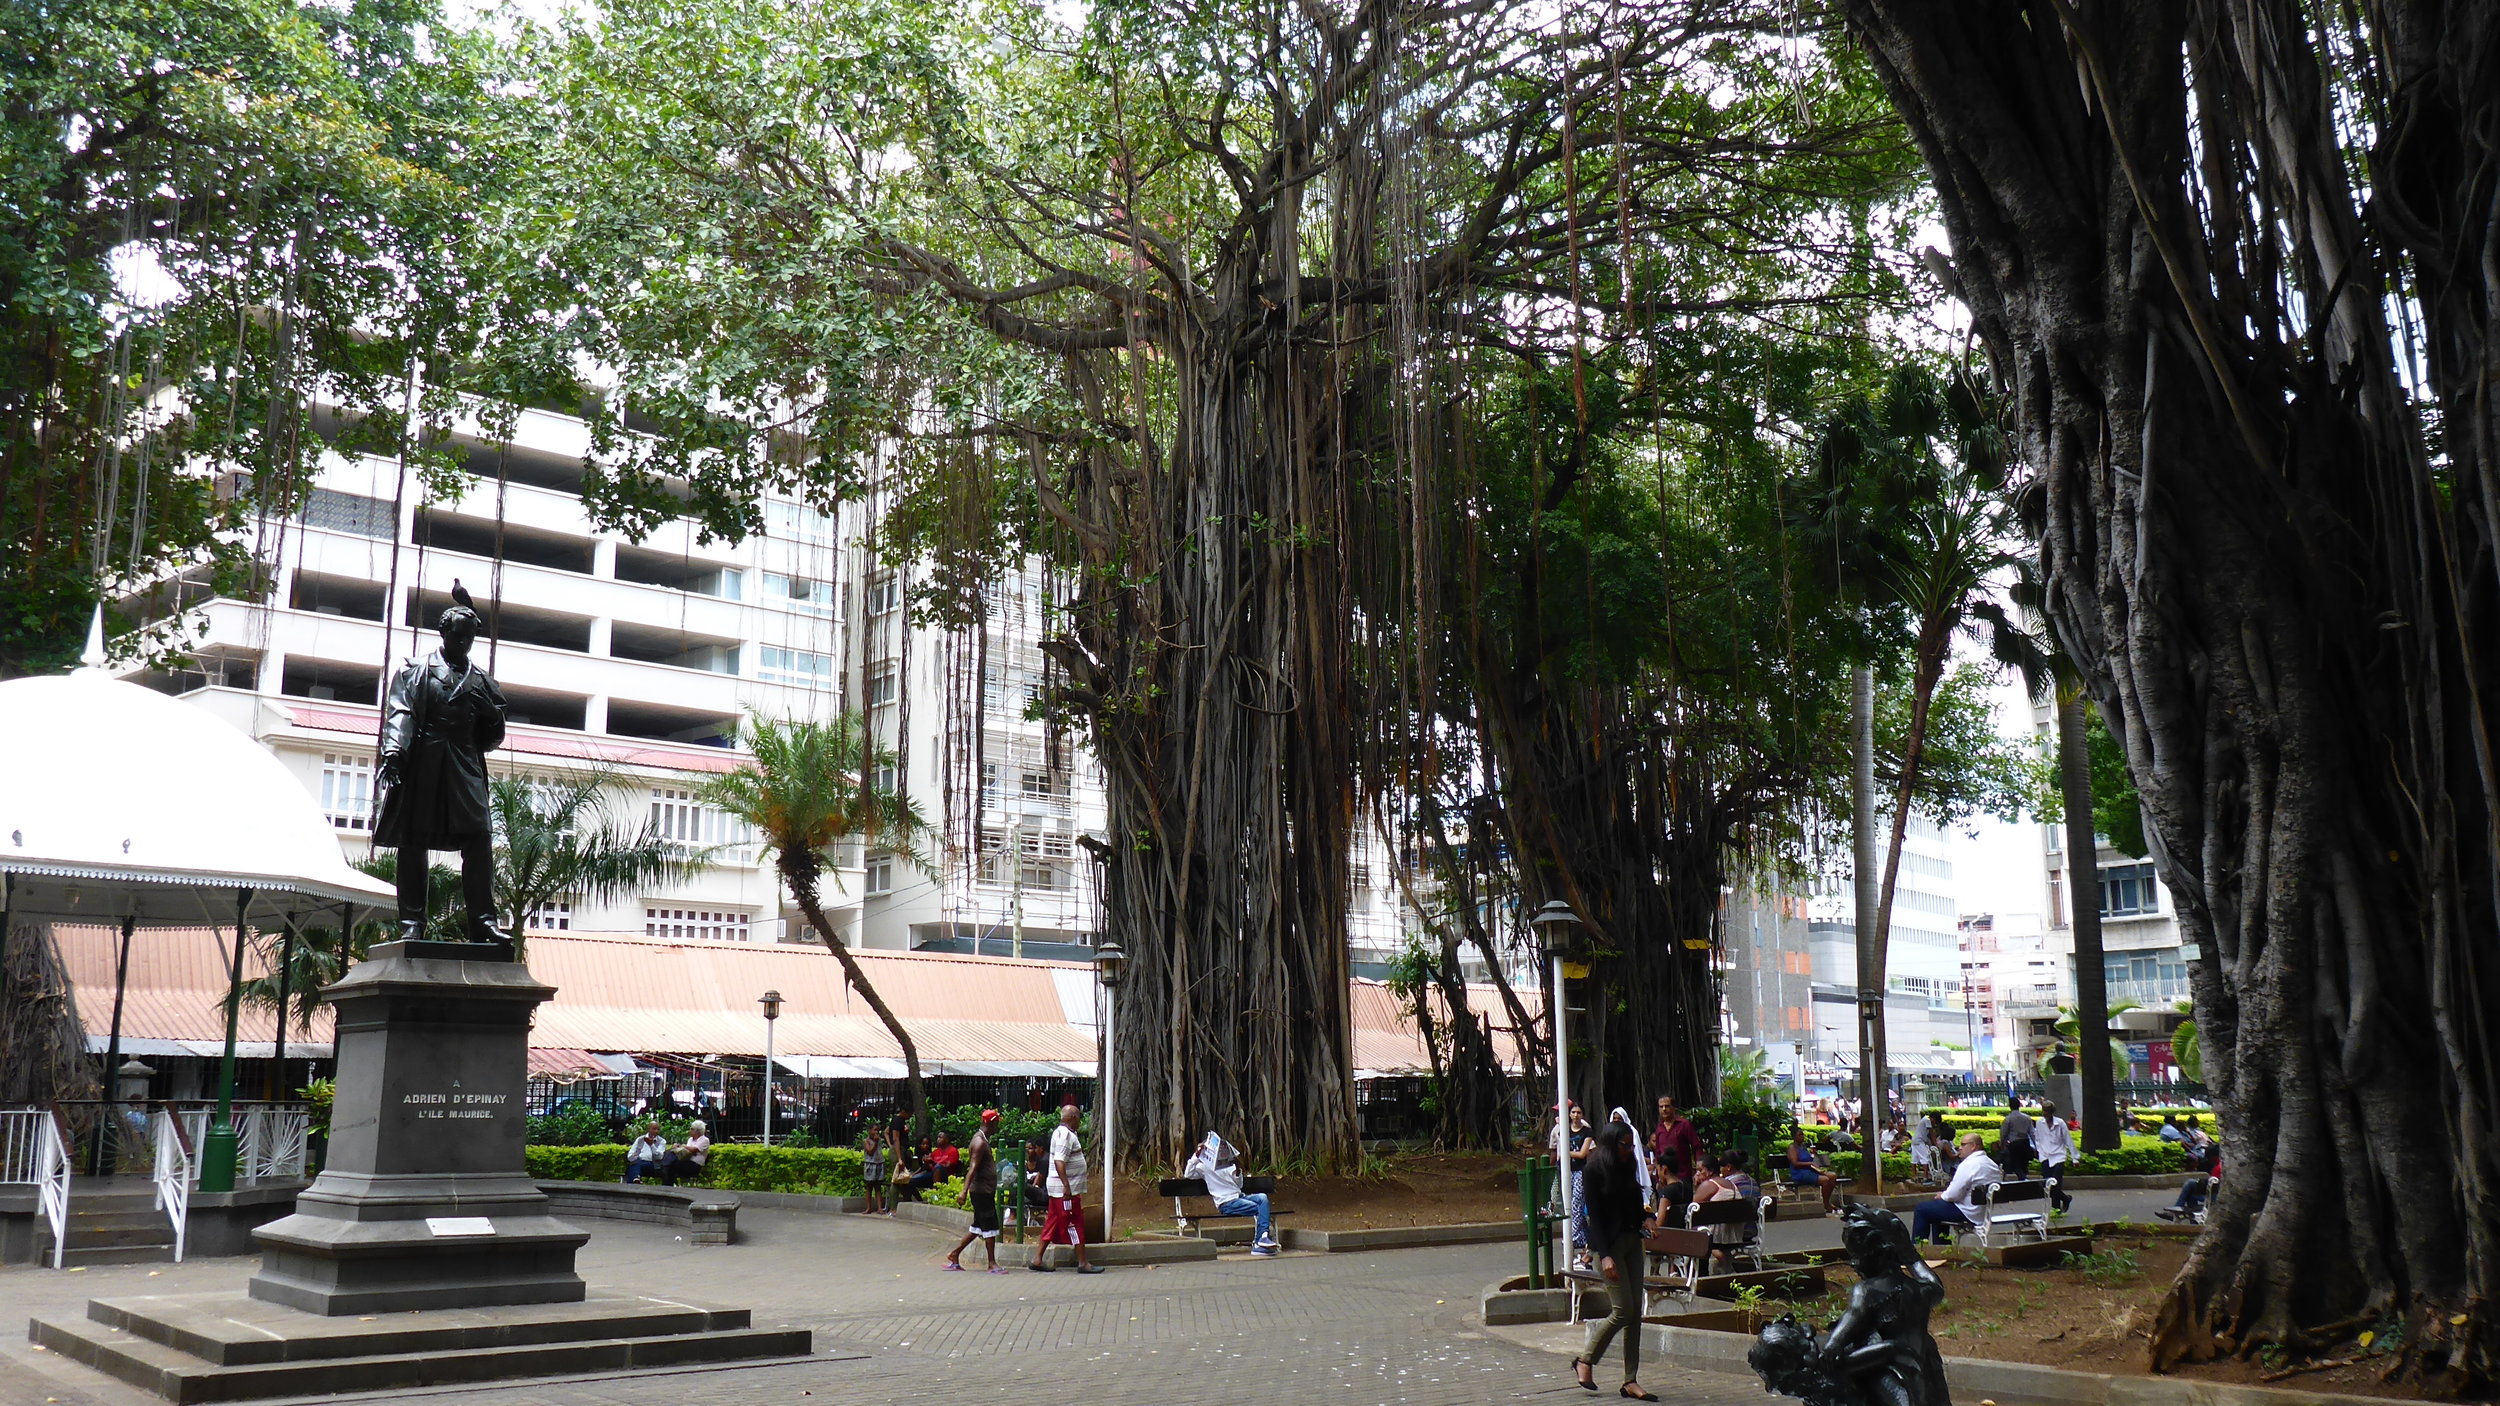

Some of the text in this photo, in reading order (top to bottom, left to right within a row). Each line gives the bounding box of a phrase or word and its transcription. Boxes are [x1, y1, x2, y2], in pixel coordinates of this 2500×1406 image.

[403, 1094, 507, 1104] ADRIEN D'EPINAY
[418, 1110, 444, 1119] L'ILE
